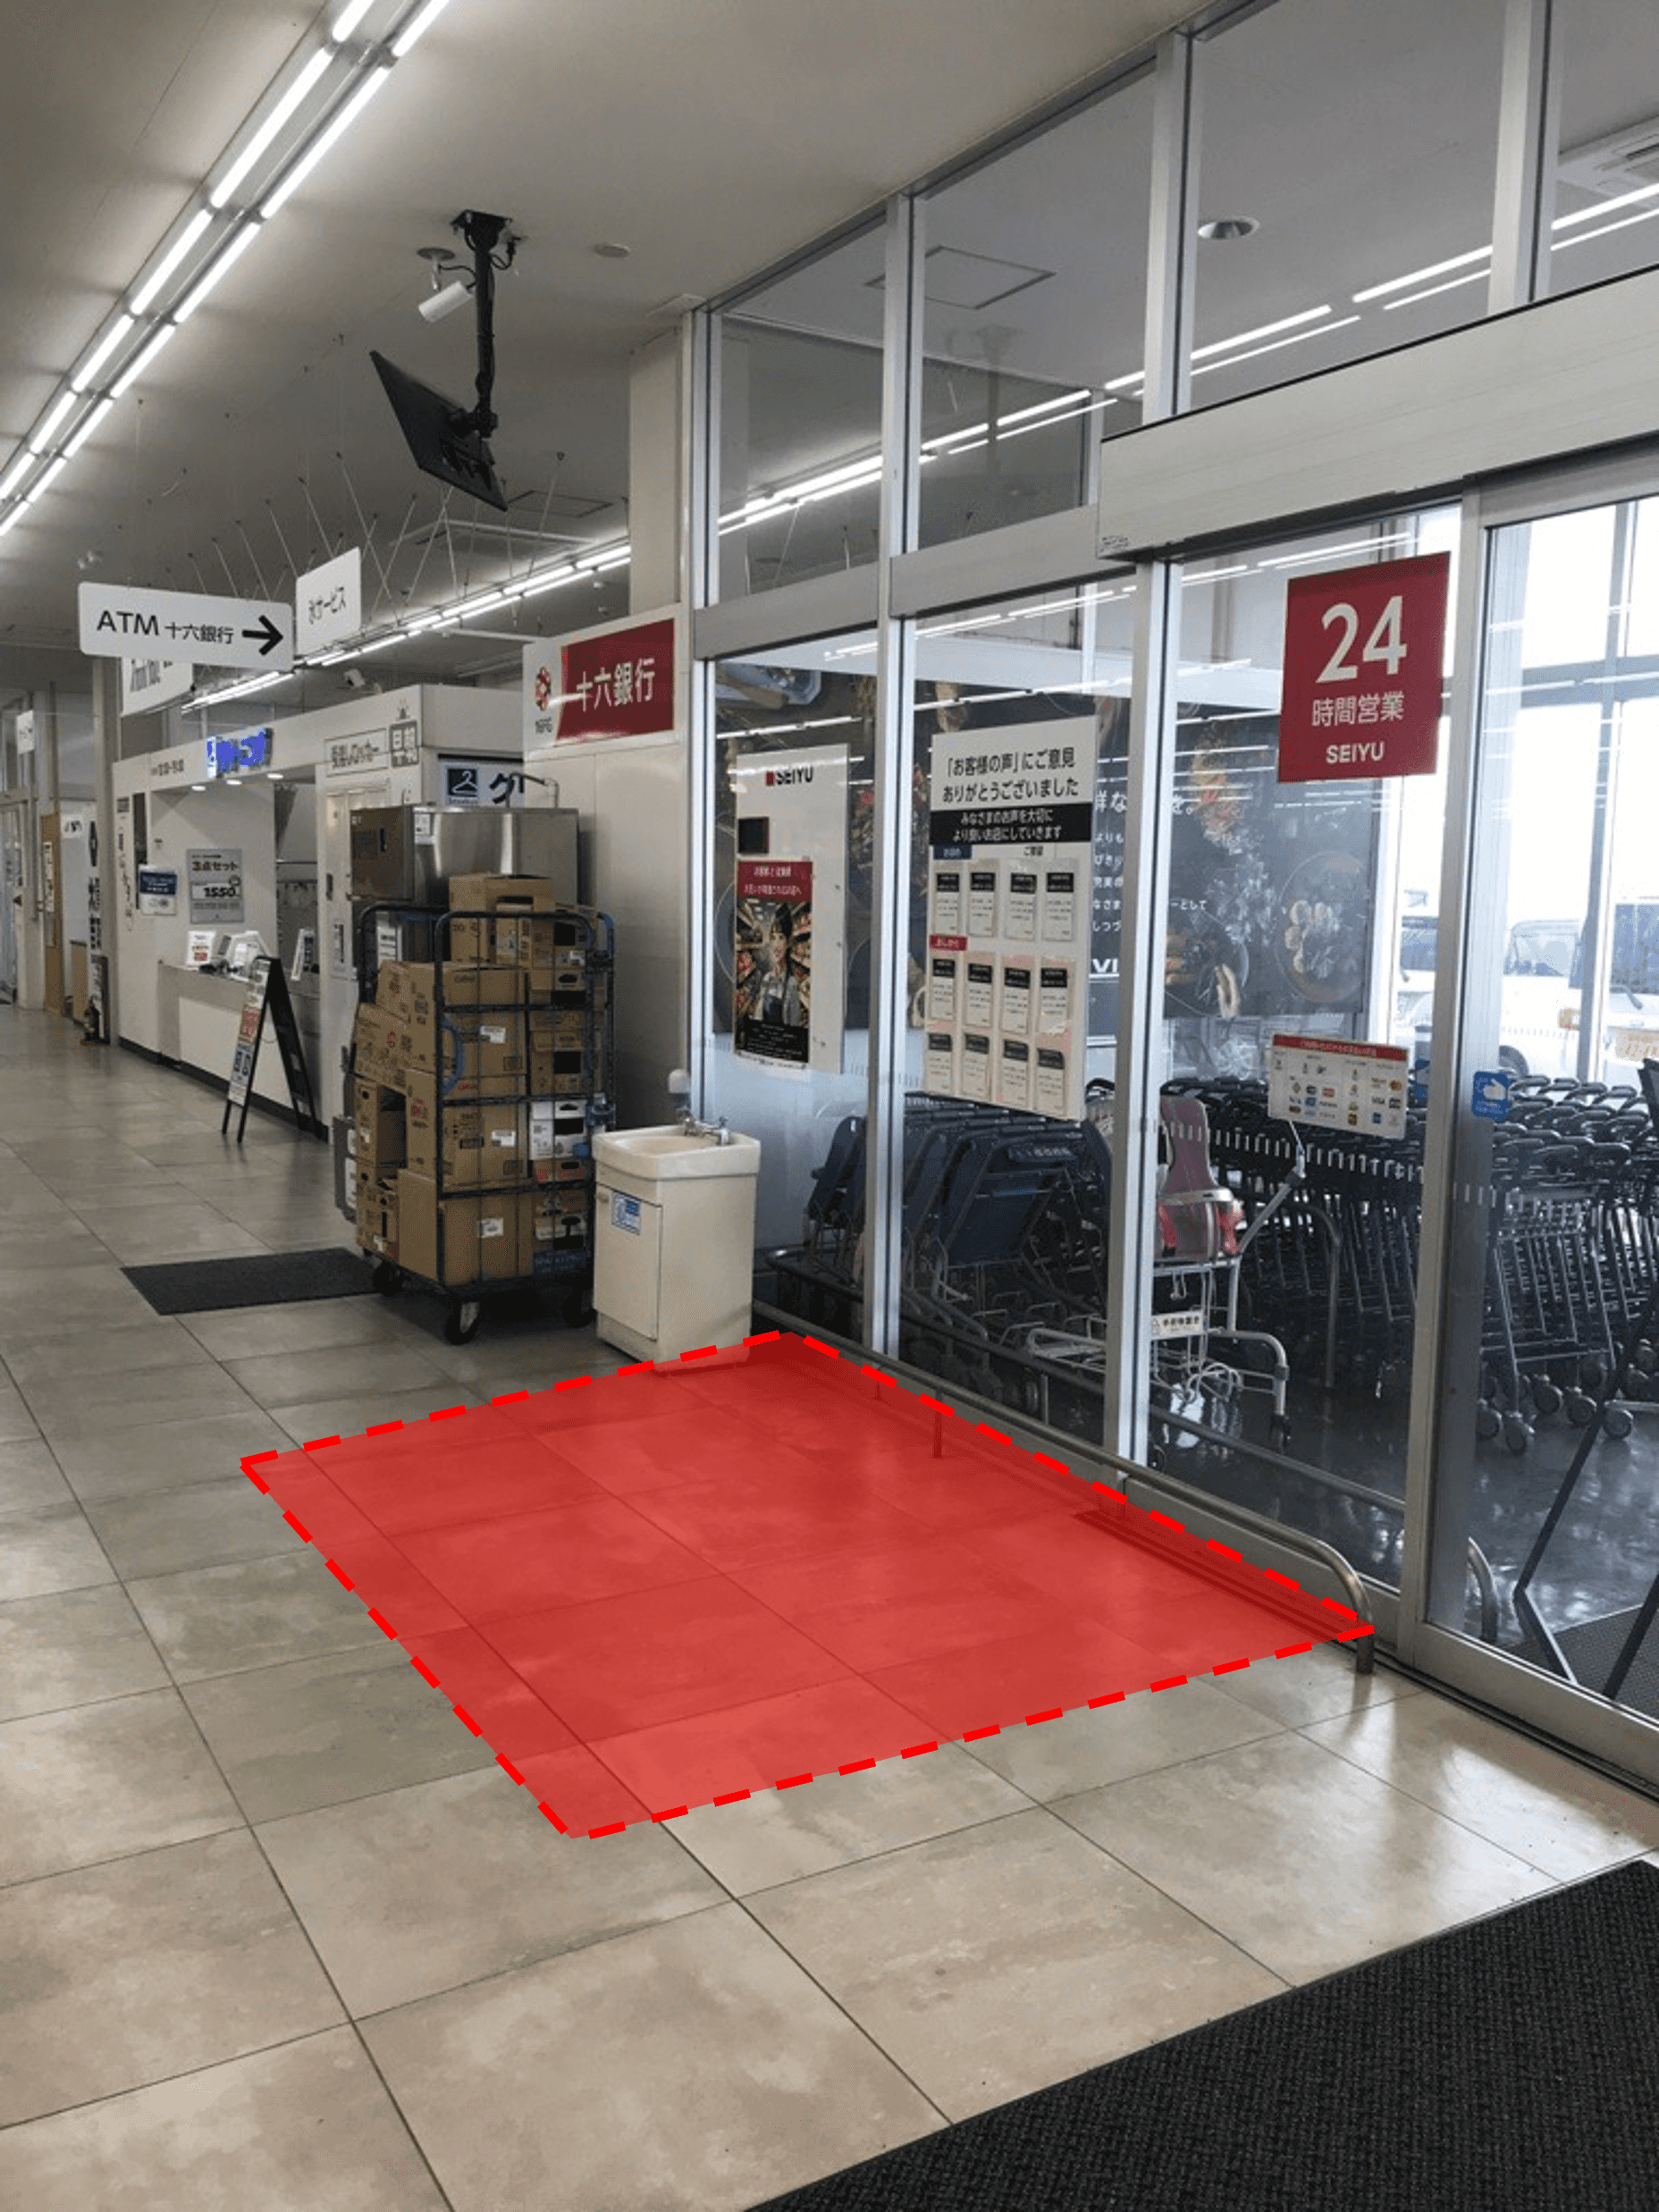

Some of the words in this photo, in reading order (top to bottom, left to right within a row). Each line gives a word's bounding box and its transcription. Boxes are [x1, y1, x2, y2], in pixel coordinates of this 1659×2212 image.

[96, 610, 160, 636] ATM
[164, 621, 234, 644] 十六銀行
[1316, 594, 1408, 685] 24
[577, 657, 656, 712] 十六銀行
[1310, 691, 1405, 728] 時間営業
[947, 746, 1076, 778] 「お客様の声」にご意見
[1326, 742, 1385, 765] SEIYU
[775, 764, 814, 786] SEIYU
[942, 777, 1079, 803] ありがとうございました
